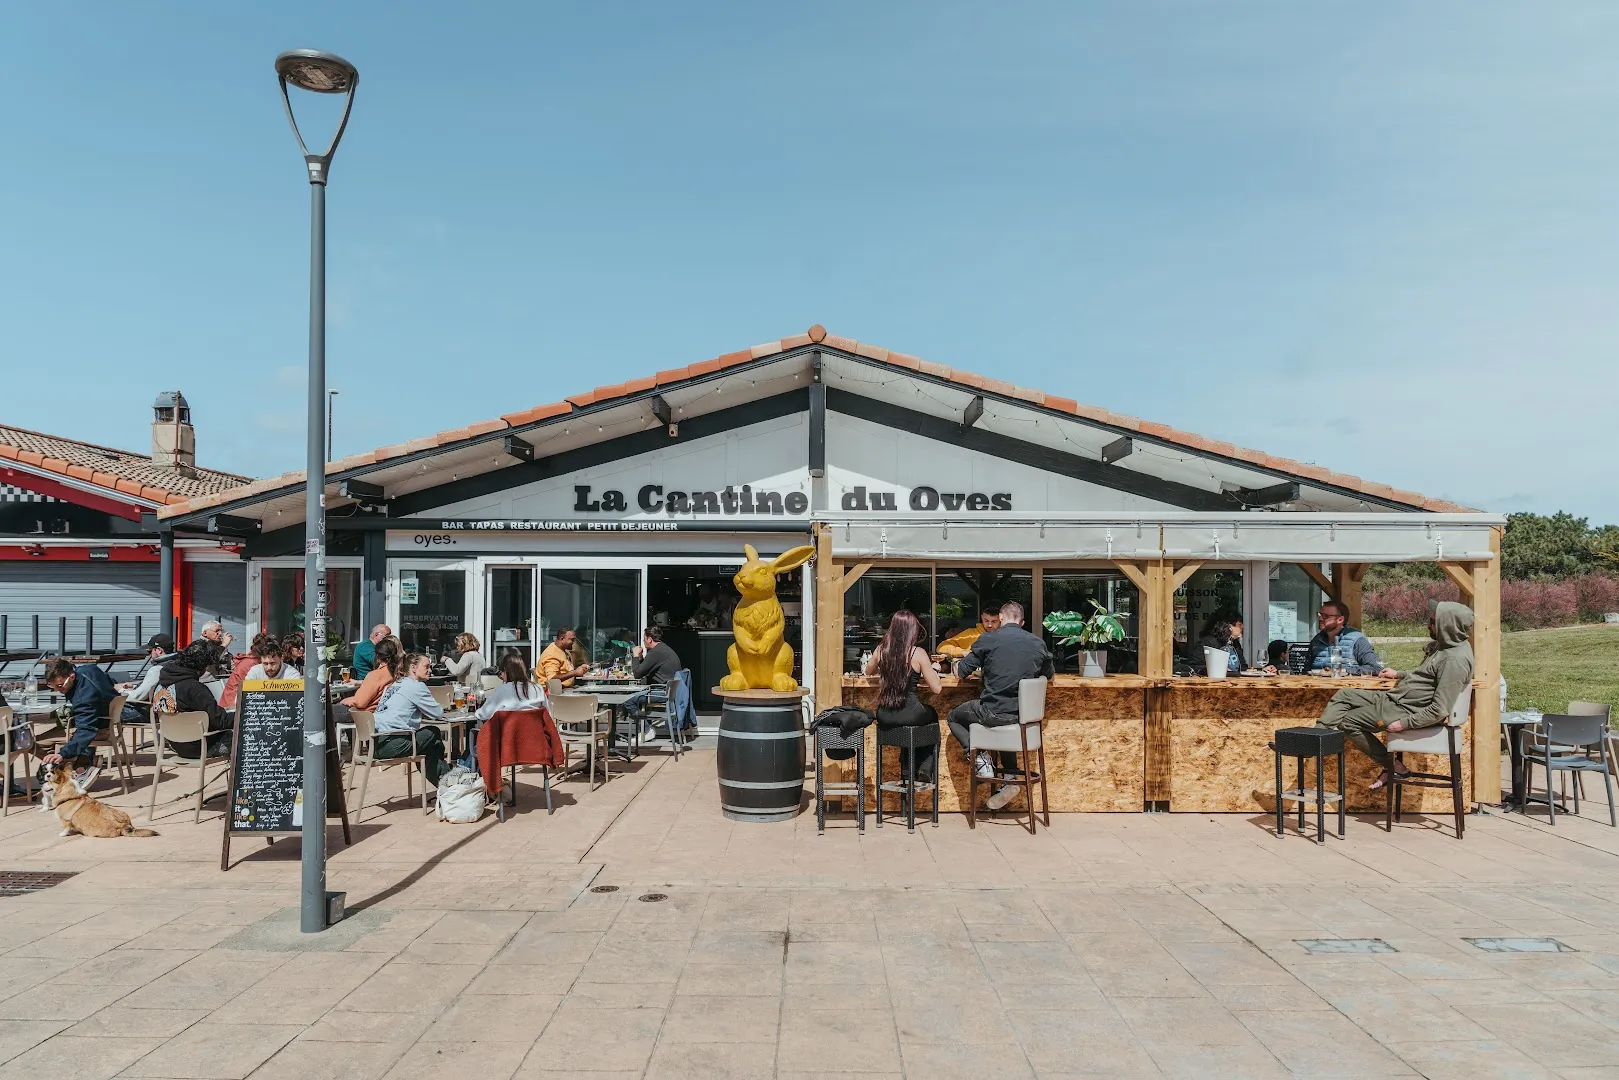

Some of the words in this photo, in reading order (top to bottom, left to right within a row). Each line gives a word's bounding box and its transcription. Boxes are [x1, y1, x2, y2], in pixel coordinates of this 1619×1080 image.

[574, 485, 627, 512] La
[638, 484, 808, 514] Cantine
[841, 486, 897, 511] du
[441, 521, 464, 530] BAR
[469, 521, 504, 530] TAPAS
[510, 521, 581, 531] RESTAURANT
[587, 522, 618, 531] PETIT
[621, 522, 678, 531] DEJEUNER
[414, 534, 457, 548] oyes.
[1173, 588, 1219, 597] UISSON
[260, 680, 300, 691] Schweppes
[235, 797, 249, 805] like
[234, 812, 248, 820] like
[234, 820, 251, 828] that.
